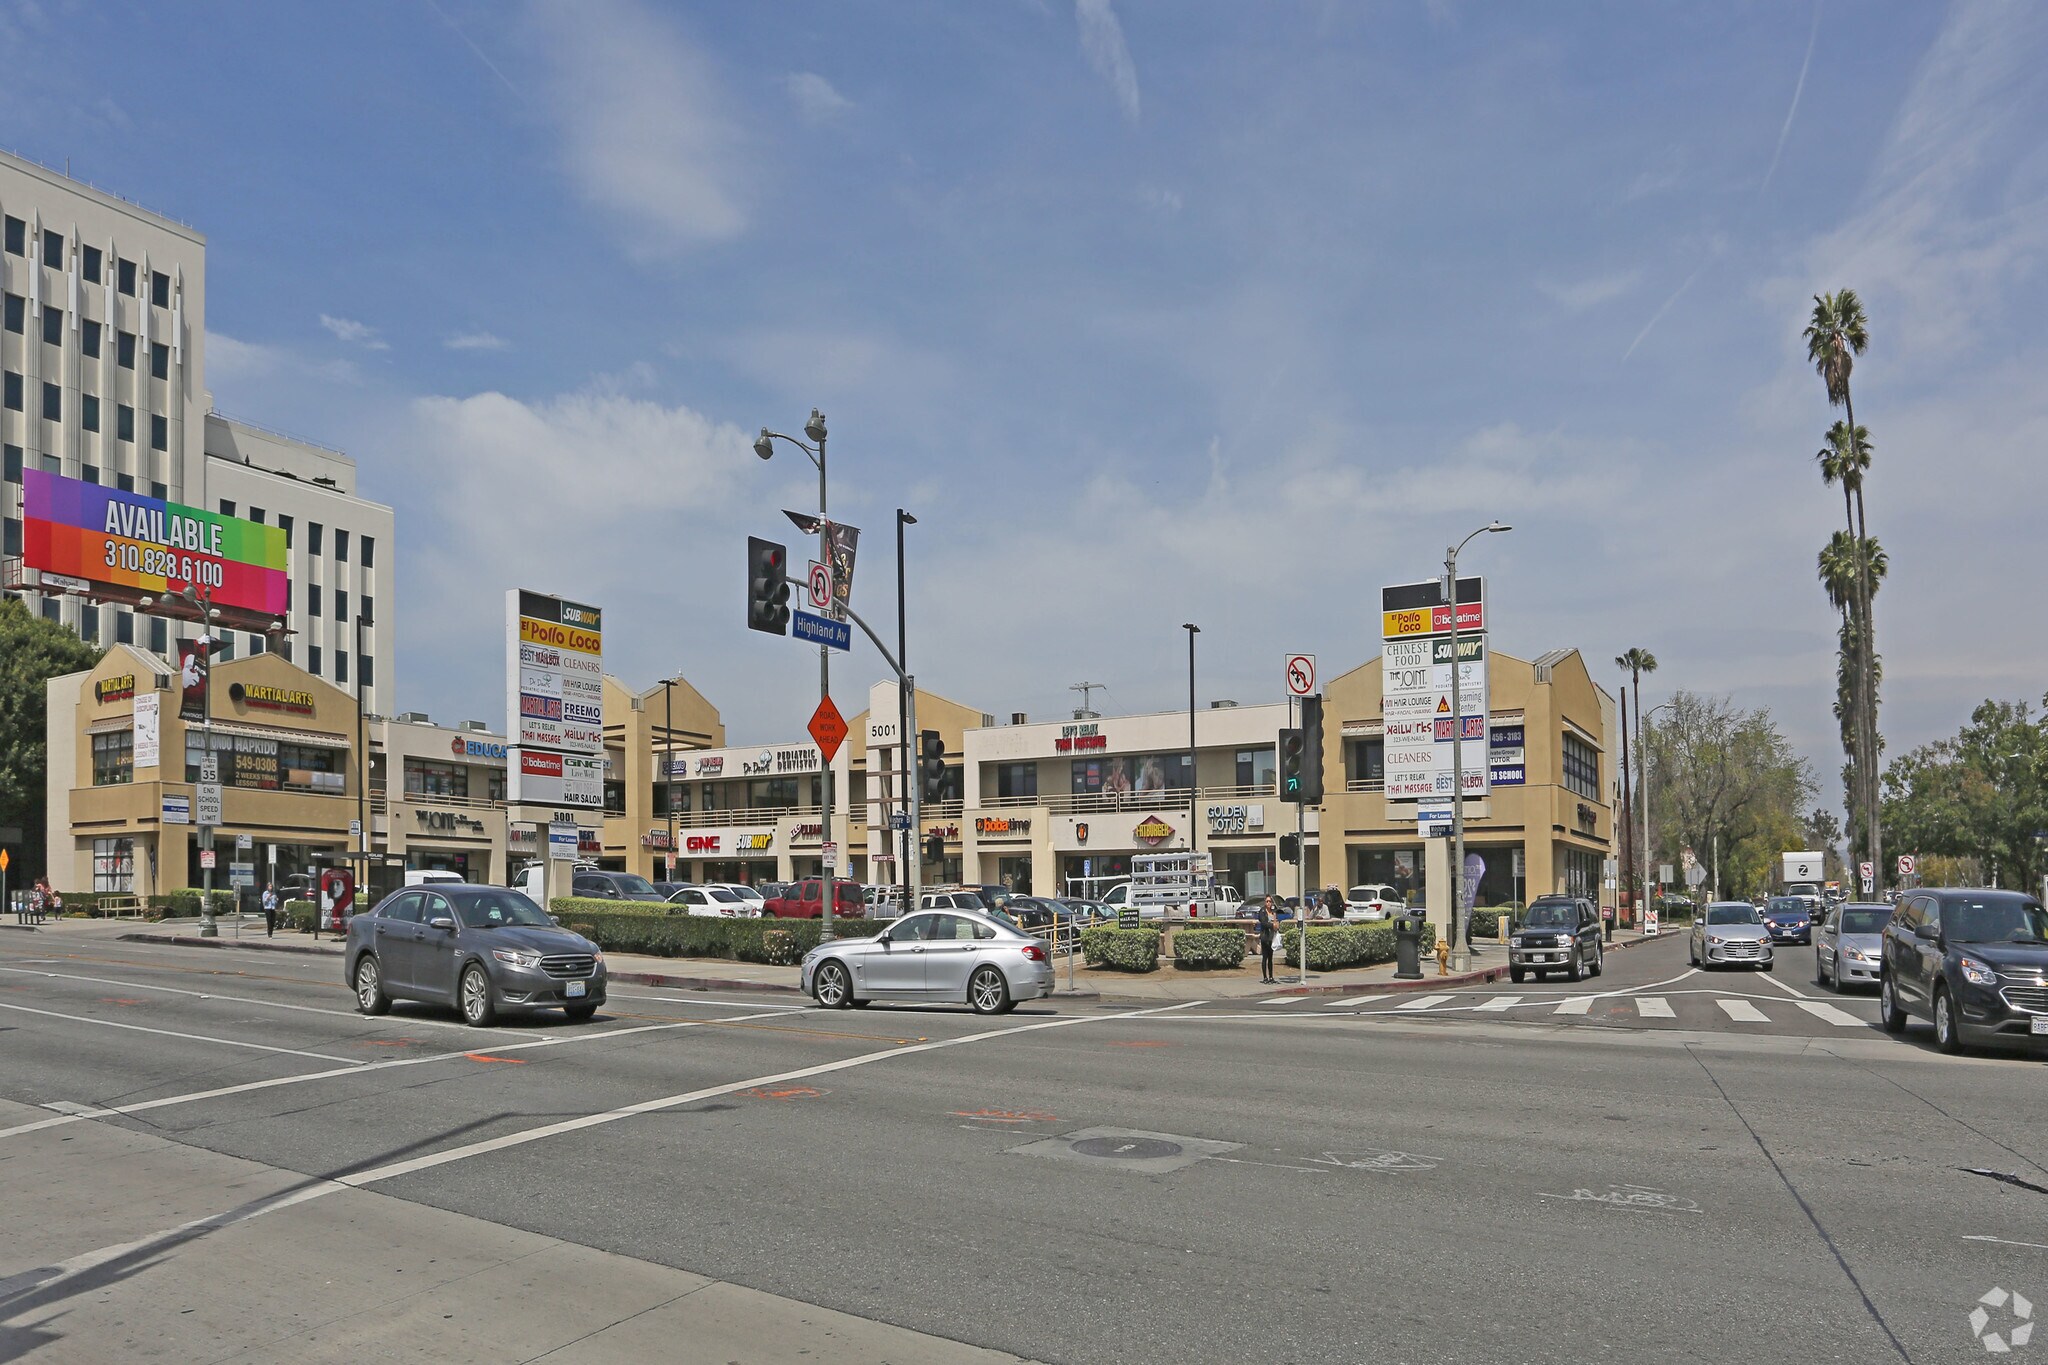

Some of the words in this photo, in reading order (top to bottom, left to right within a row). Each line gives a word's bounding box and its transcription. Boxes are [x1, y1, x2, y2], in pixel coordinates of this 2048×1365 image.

[105, 499, 223, 558] AVAILABLE
[105, 539, 223, 588] 310.828.6100
[563, 607, 599, 625] SUBWAY
[1397, 612, 1421, 624] Pollo
[1441, 612, 1481, 625] boatime
[797, 617, 834, 639] Highland
[836, 630, 847, 643] Av
[1398, 622, 1421, 633] Loco
[521, 621, 529, 631] El
[531, 621, 565, 645] Pollo
[569, 630, 600, 652] Loco
[520, 648, 535, 662] BEST
[1387, 642, 1428, 656] CHINESE
[1434, 640, 1482, 659] SUWAY
[563, 657, 600, 673] CLEANERS
[1395, 655, 1421, 666] FOOD
[101, 677, 120, 694] MARTIAL
[121, 674, 134, 692] ARTS
[1399, 669, 1426, 687] JOINT
[582, 681, 601, 693] LOUNGE
[245, 684, 287, 703] MARTIAL
[288, 690, 314, 706] ARTS
[1459, 691, 1482, 703] earning
[521, 696, 546, 716] MARTIAL
[1393, 698, 1407, 707] HAIR
[1407, 697, 1432, 706] LOUNGE
[564, 702, 600, 719] FREEMO
[819, 711, 835, 720] ROAD
[541, 722, 556, 732] RELAX
[819, 723, 836, 731] WORK
[871, 724, 896, 737] 5001
[1465, 717, 1484, 738] ARTS
[522, 730, 535, 741] THAI
[536, 731, 561, 744] MASSAGE
[819, 736, 839, 744] AHEAD
[234, 737, 278, 755] HAPKIDO
[777, 749, 816, 760] PEDIATRIC
[1387, 751, 1432, 764] CLEANERS
[235, 755, 278, 772] 549-0308
[528, 757, 561, 770] bobatime
[564, 758, 601, 770] GNC
[777, 759, 818, 770] DENTISTRY
[202, 770, 216, 780] 35
[240, 772, 261, 780] WEEKS
[261, 773, 277, 781] TRIAL
[571, 768, 582, 778] Live
[583, 770, 595, 779] Well
[1394, 774, 1408, 782] LET'S
[1409, 773, 1426, 781] RELAX
[1498, 770, 1523, 780] SCHOOL
[1387, 784, 1402, 795] THAI
[1404, 783, 1433, 793] MASSAGE
[1436, 779, 1453, 789] BEST
[564, 793, 580, 803] HAIR
[580, 794, 602, 805] SALON
[554, 811, 574, 822] 5001
[1207, 805, 1247, 818] GOLDEN
[790, 823, 801, 837] TLC
[984, 817, 1031, 832] bobatime
[1211, 817, 1245, 831] LOTUS
[687, 836, 720, 849] GNC
[736, 832, 772, 850] SUBWAY
